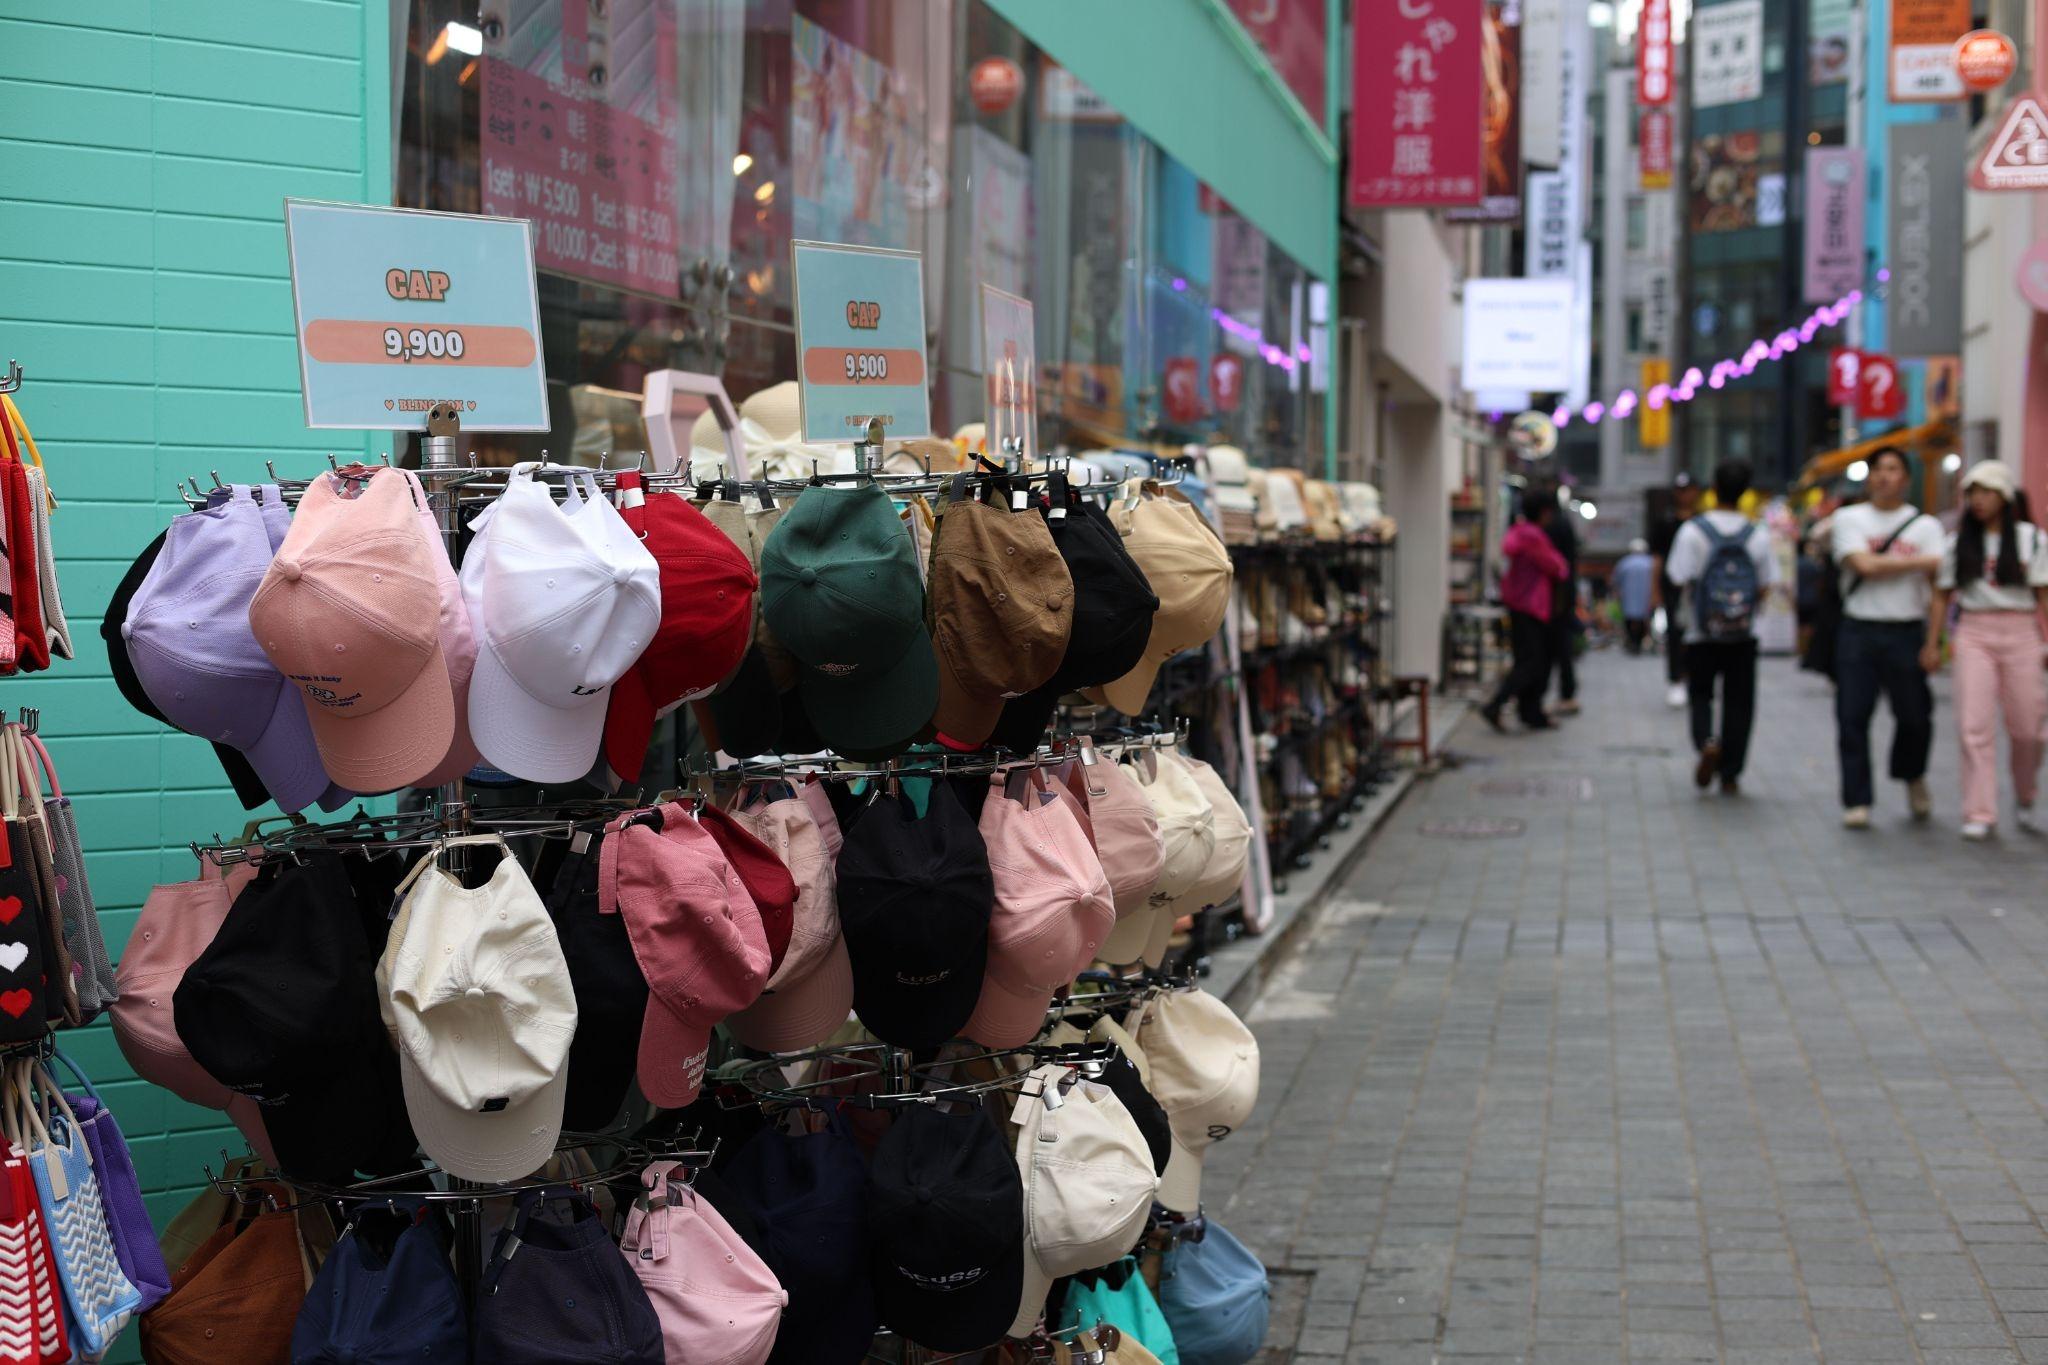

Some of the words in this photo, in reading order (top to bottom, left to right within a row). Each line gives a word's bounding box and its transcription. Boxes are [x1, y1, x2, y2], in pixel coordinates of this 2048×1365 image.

[385, 268, 451, 302] CAP
[846, 300, 881, 330] CAP
[383, 327, 465, 364] 9,900
[844, 353, 888, 385] 9,900
[438, 399, 465, 412] OX
